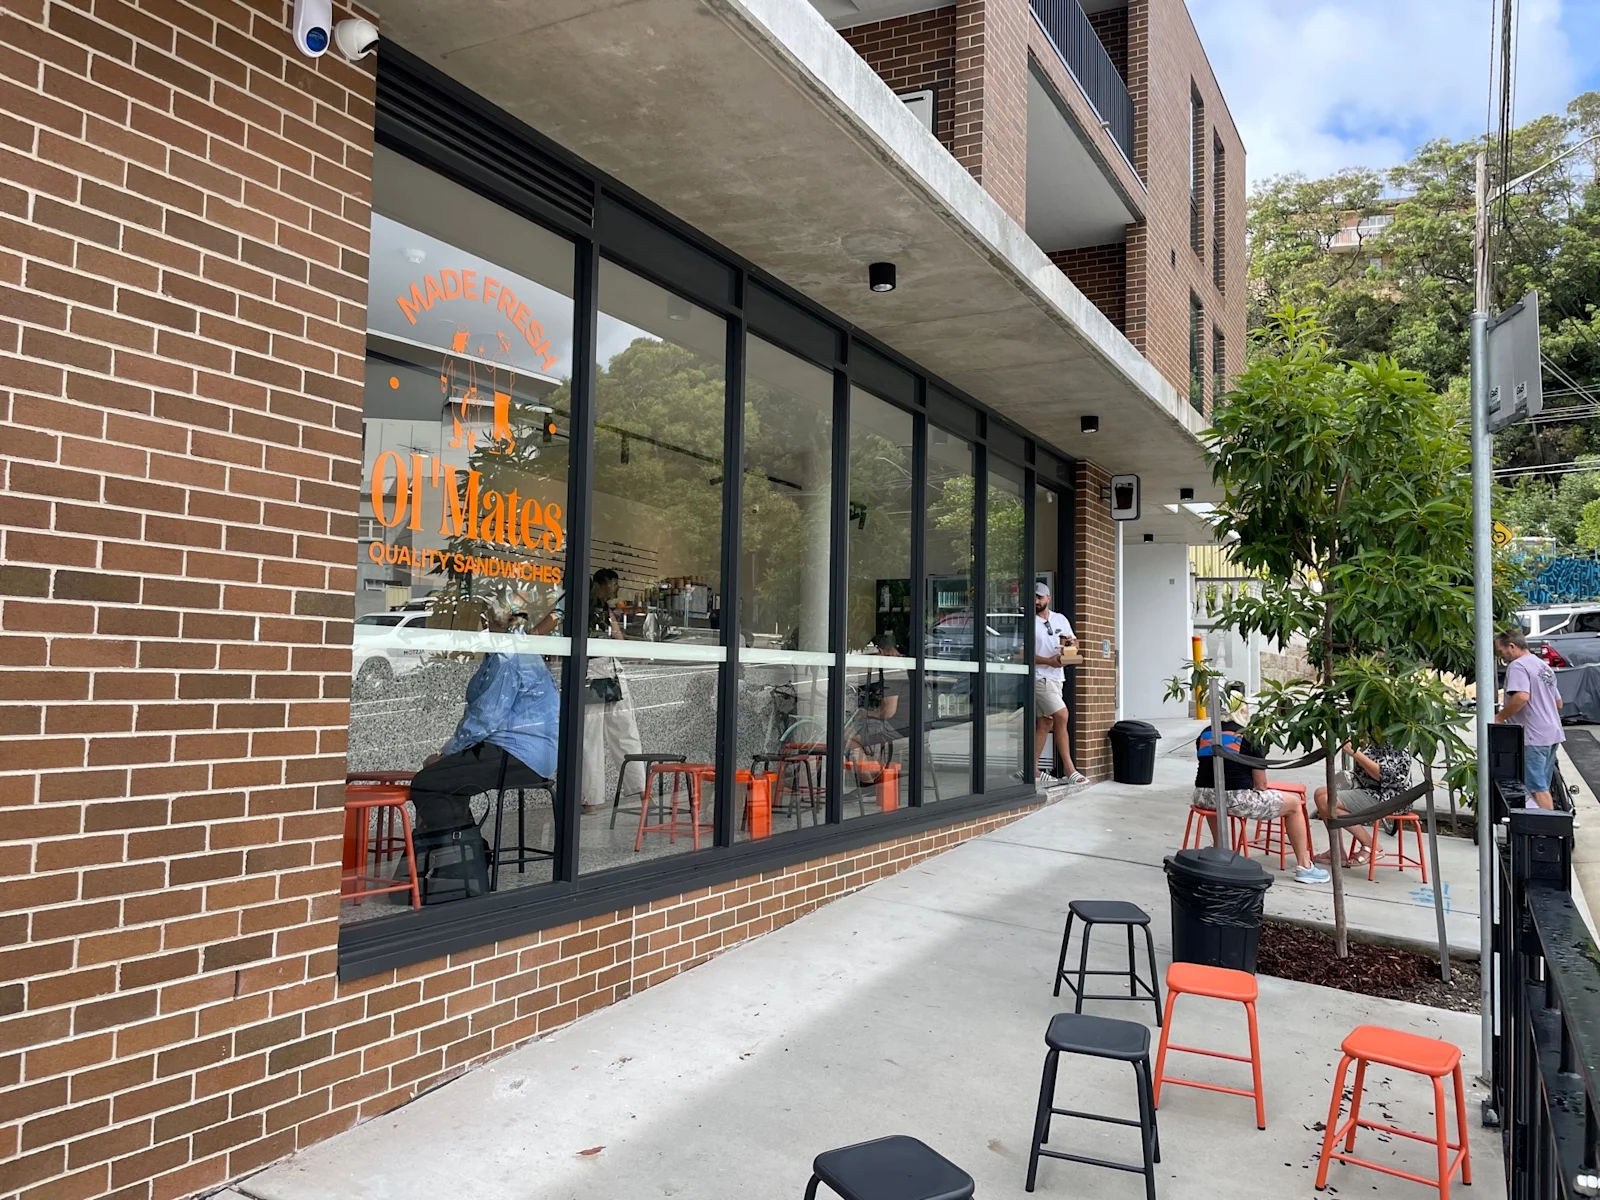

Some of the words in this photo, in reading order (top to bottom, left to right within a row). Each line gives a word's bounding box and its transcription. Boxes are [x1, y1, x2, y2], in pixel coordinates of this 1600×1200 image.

[396, 268, 478, 325] MADE
[482, 275, 558, 372] FRESH
[368, 541, 451, 570] QUALITY
[453, 552, 562, 585] SANDWICHES
